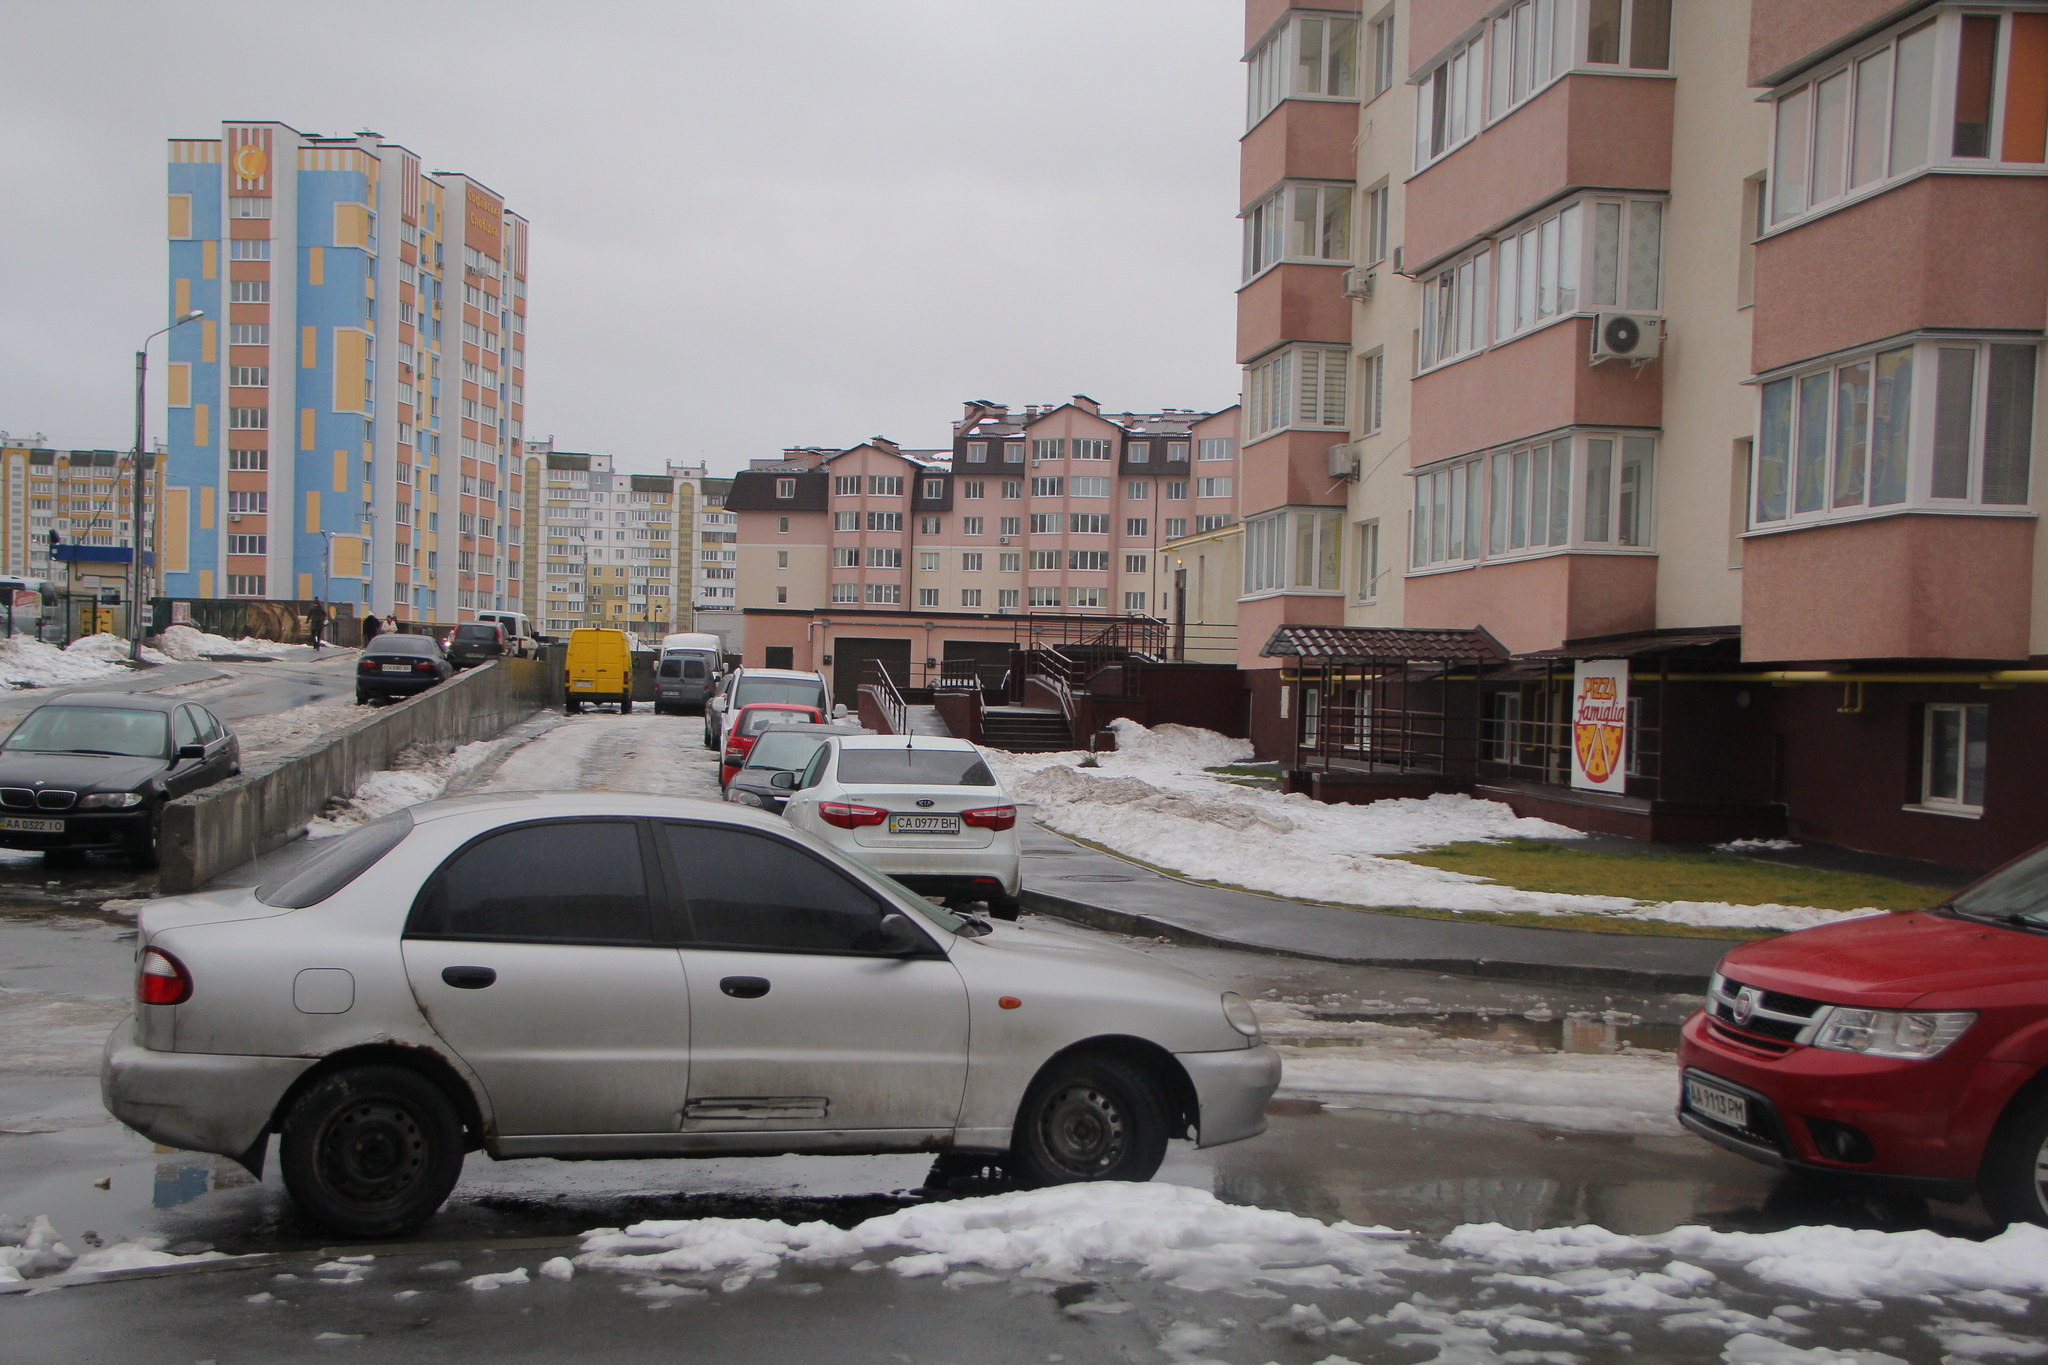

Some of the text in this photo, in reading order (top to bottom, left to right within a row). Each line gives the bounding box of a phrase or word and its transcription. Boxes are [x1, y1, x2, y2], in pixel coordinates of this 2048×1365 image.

[1583, 677, 1618, 700] PIZZA
[1577, 695, 1625, 725] Famiglia
[6, 819, 20, 829] AA
[22, 820, 45, 830] 0322
[897, 817, 913, 828] CA
[915, 818, 939, 828] 0977
[941, 818, 957, 828] BH
[1691, 1083, 1744, 1121] AA 9113 PM
